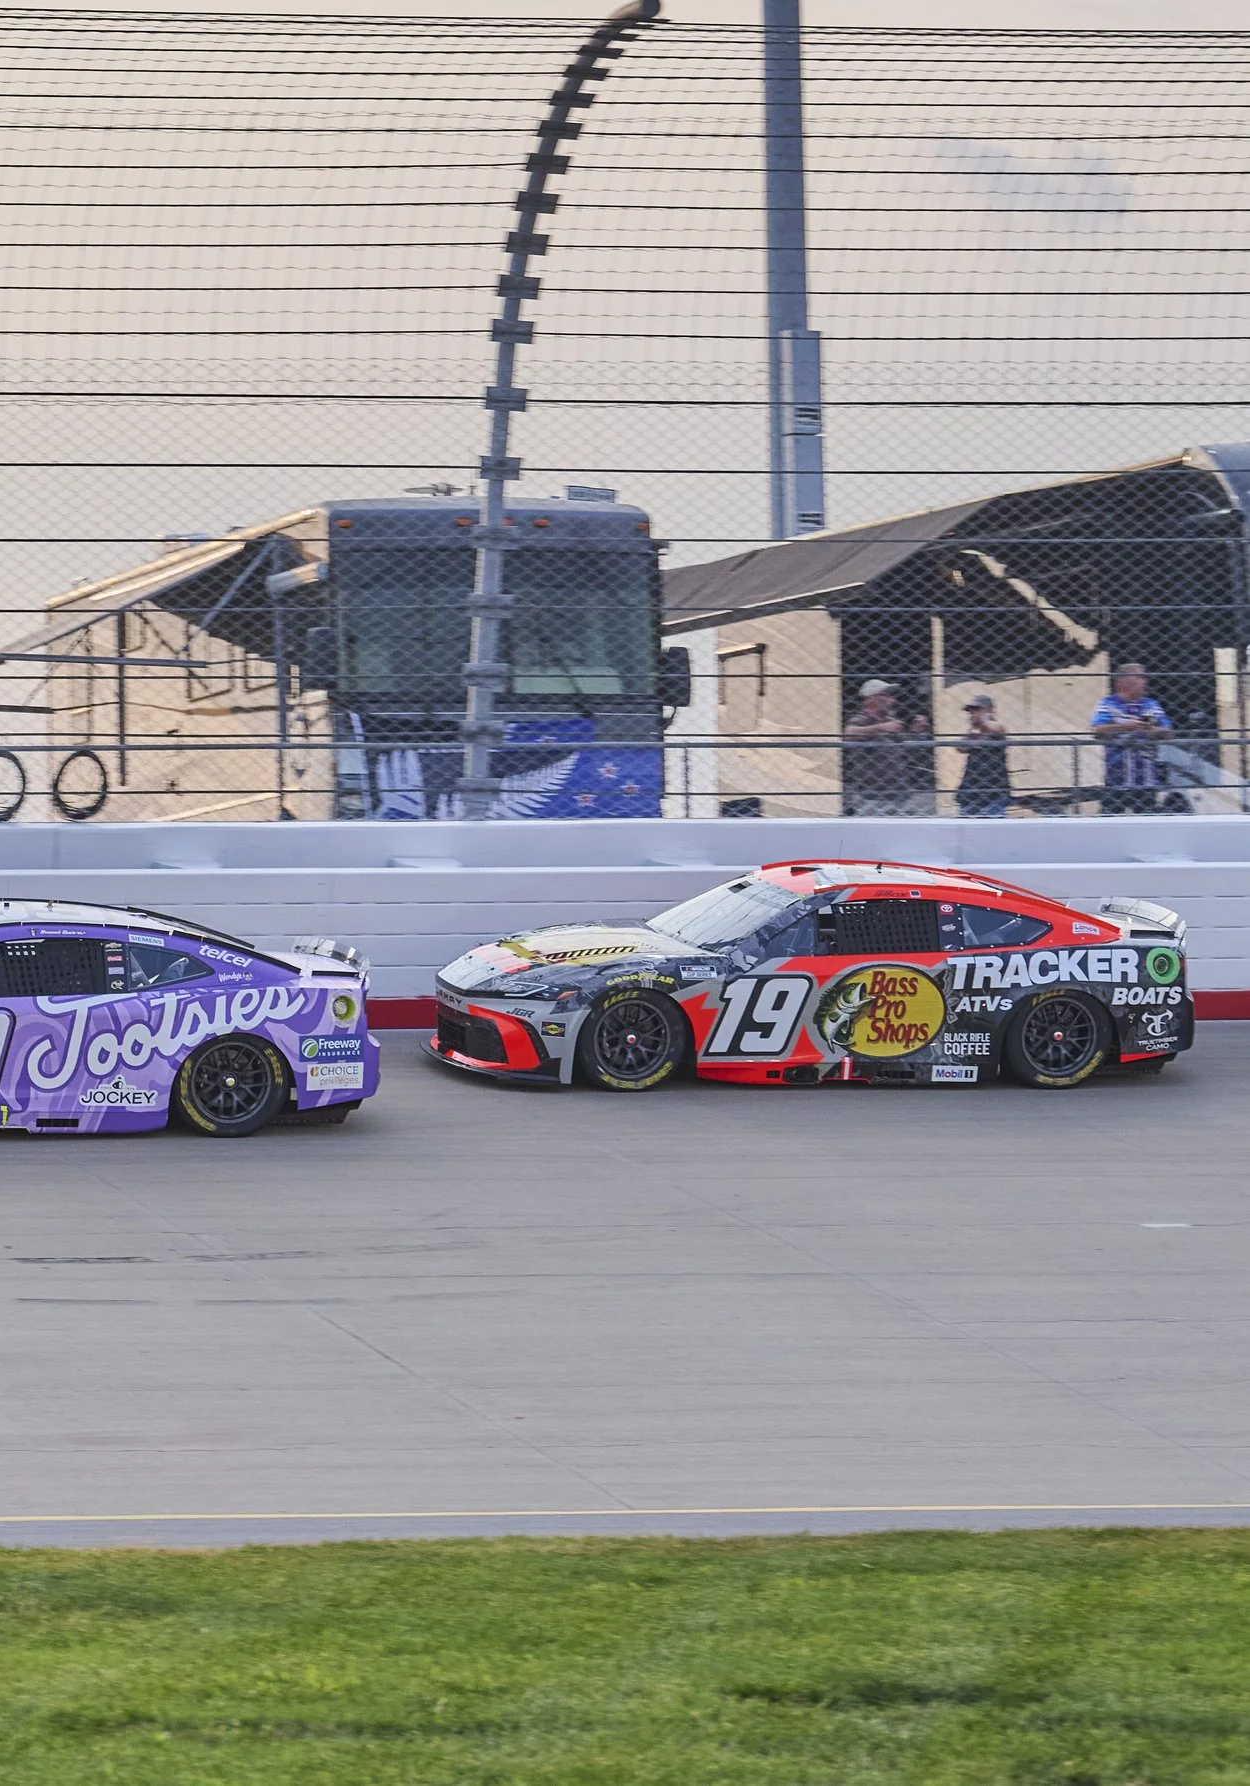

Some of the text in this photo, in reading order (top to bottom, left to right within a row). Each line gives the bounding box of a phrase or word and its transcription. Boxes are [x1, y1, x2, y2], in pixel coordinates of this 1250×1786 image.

[130, 935, 163, 945] SIEMENS
[199, 944, 253, 968] telcel
[218, 971, 243, 982] Wendy's
[947, 949, 1139, 990] TRACKER
[606, 971, 675, 986] GOODYEAR
[868, 970, 919, 997] Bass
[1111, 986, 1183, 1005] BOATS
[867, 994, 907, 1020] Pro
[954, 996, 1014, 1013] ATVs
[507, 1007, 536, 1019] JGR
[706, 976, 811, 1054] 19
[26, 986, 306, 1090] Tootsies
[867, 1017, 930, 1048] Shops
[943, 1033, 991, 1043] BLACK RIFLE
[318, 1038, 361, 1050] Freeway
[943, 1042, 991, 1055] COFFEE
[1145, 1043, 1170, 1052] CAMO
[320, 1065, 360, 1077] CHOICE
[935, 1069, 974, 1079] Mobil 1
[319, 1076, 360, 1087] privileges
[81, 1091, 155, 1105] JOCKEY
